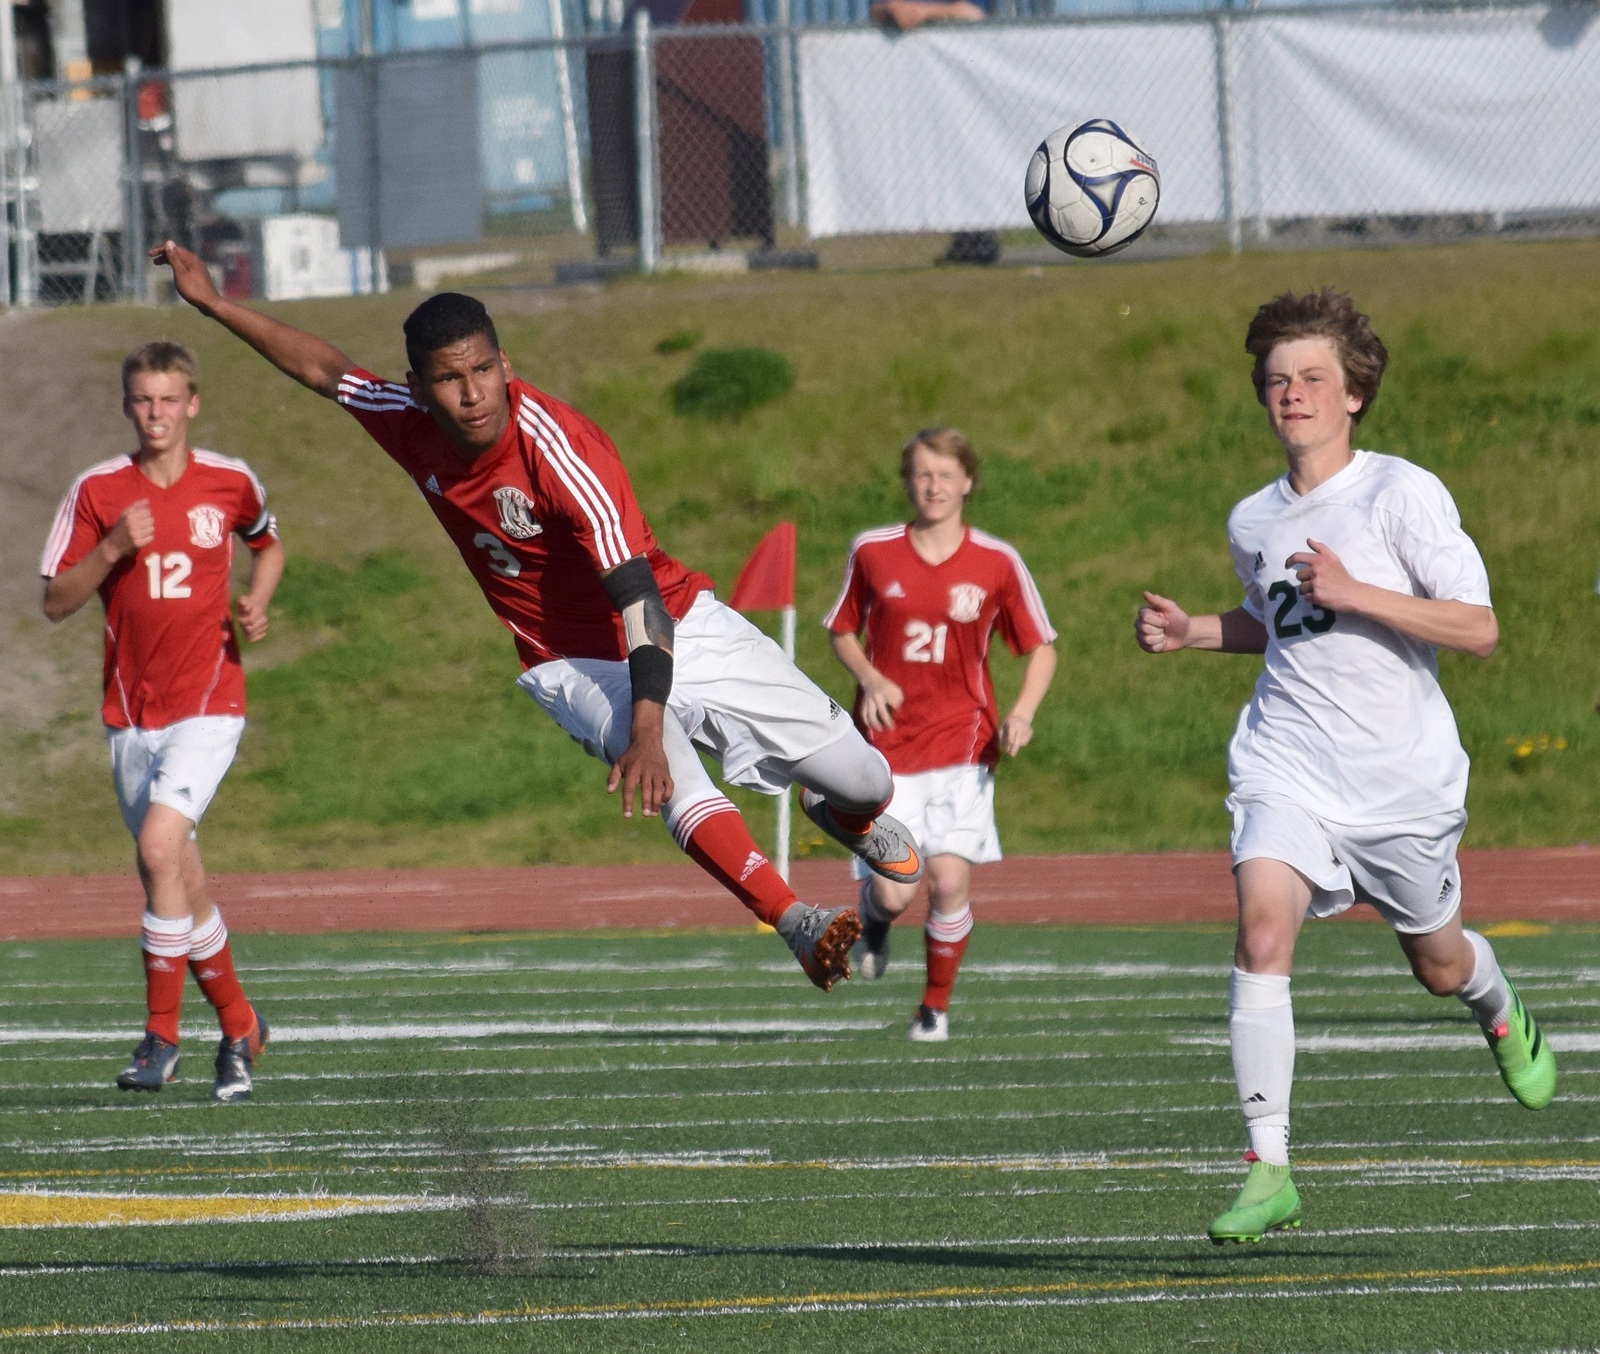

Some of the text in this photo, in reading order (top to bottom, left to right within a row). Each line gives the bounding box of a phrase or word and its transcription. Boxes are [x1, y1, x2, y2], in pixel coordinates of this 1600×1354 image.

[145, 552, 192, 599] 12
[474, 533, 521, 577] 3
[904, 620, 948, 664] 21
[740, 858, 769, 882] adidas
